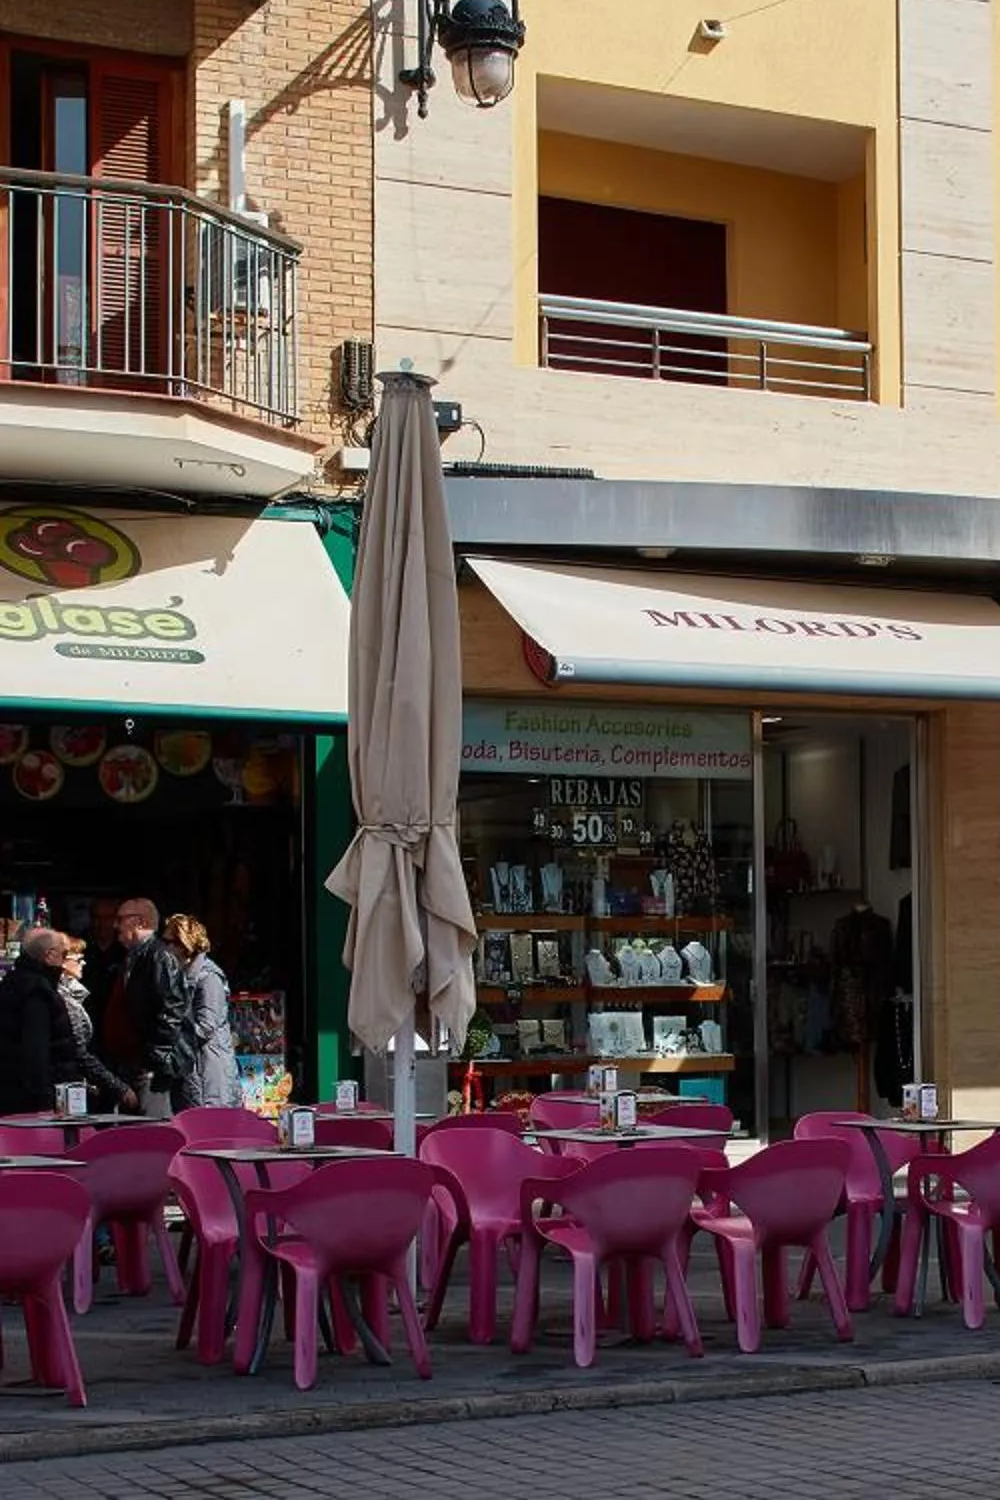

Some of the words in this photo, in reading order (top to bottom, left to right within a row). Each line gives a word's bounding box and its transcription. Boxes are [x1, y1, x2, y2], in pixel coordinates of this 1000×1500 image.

[640, 609, 923, 641] MILORD'S
[99, 646, 191, 662] MILORD'S
[504, 711, 581, 735] Fashion
[461, 741, 503, 763] oda,
[610, 744, 750, 773] Complementos
[551, 779, 641, 806] REBAJAS
